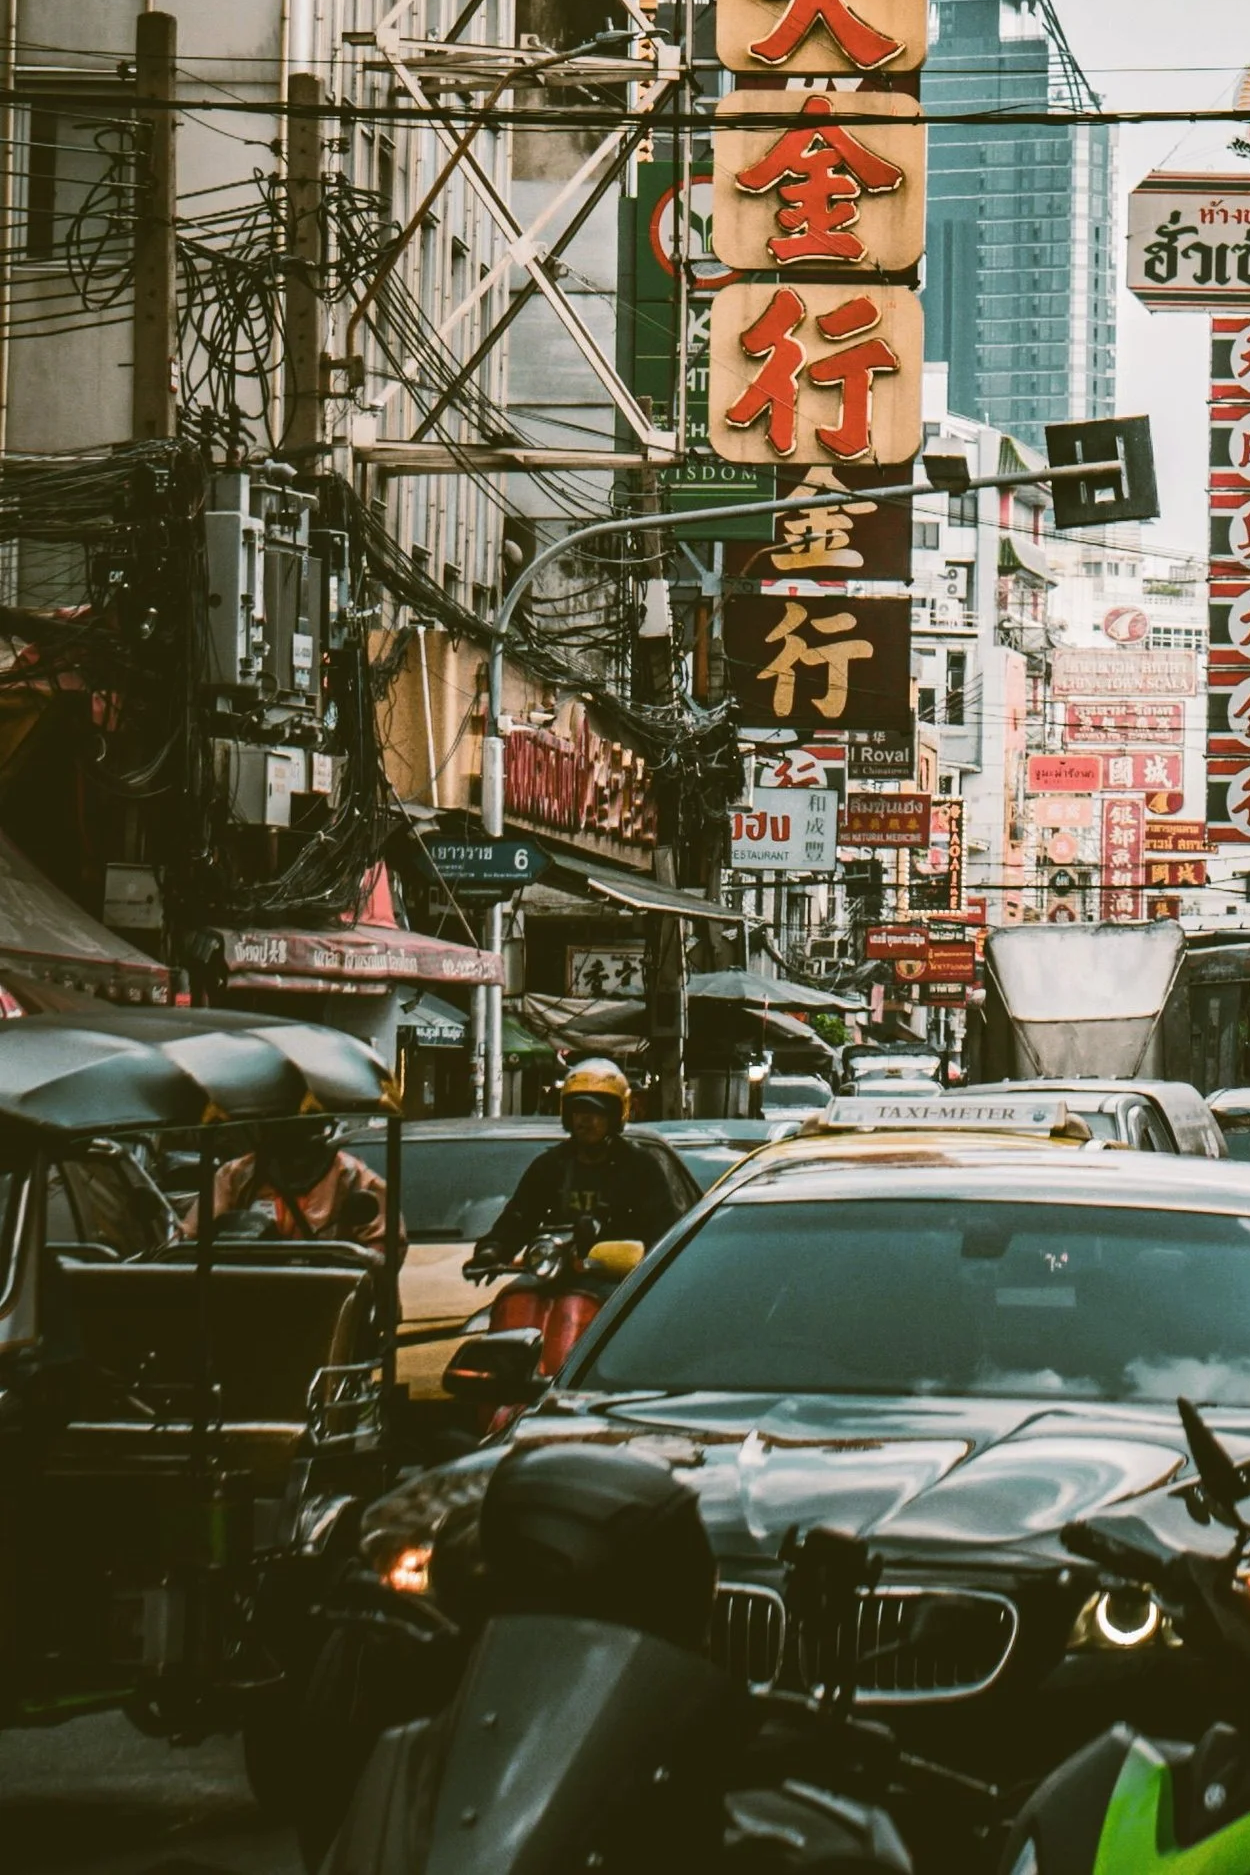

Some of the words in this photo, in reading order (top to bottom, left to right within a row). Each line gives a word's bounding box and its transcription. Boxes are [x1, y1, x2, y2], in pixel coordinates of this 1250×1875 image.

[1147, 678, 1188, 690] SCALA
[861, 747, 909, 764] Royal
[514, 849, 529, 870] 6
[731, 849, 789, 861] ESTAURANT
[878, 1105, 1015, 1121] TAXI-METER
